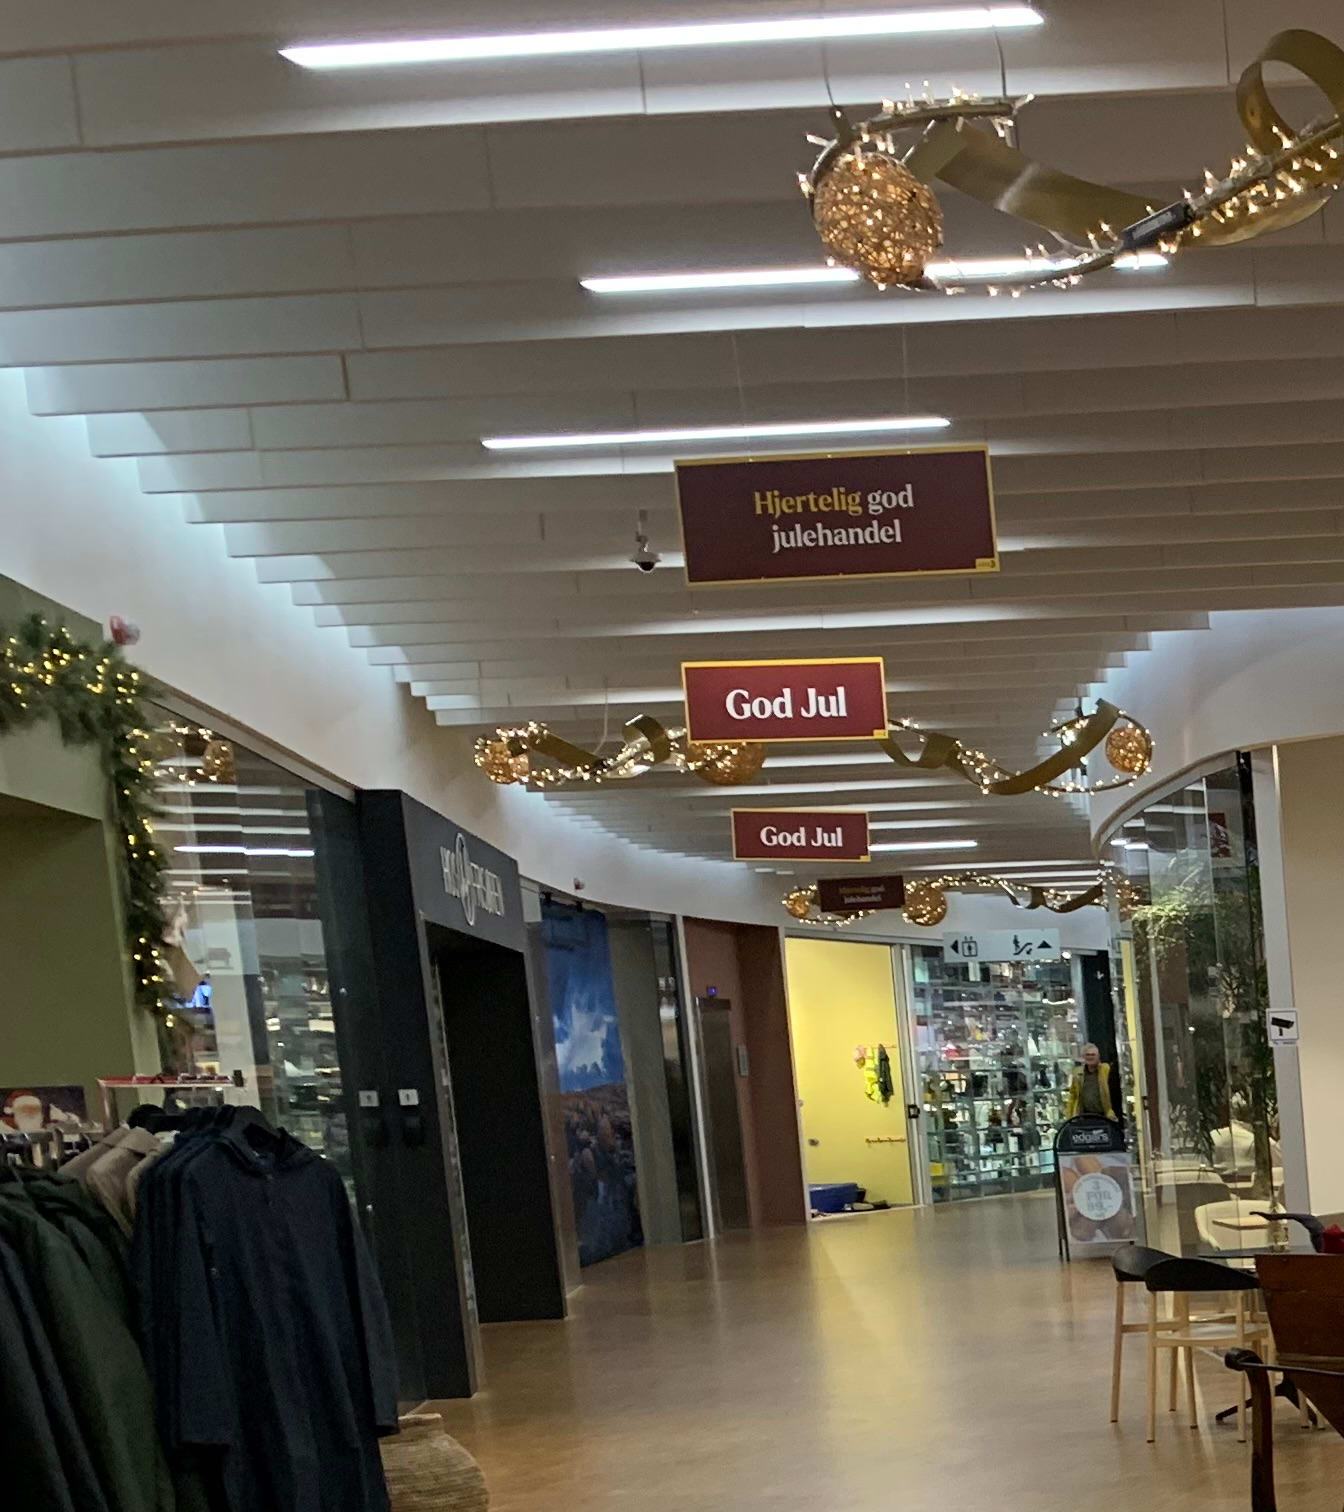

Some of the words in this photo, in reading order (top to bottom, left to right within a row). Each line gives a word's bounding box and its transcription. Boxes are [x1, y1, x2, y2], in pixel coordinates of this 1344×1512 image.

[754, 487, 863, 519] Hjertelig
[867, 484, 915, 514] god
[772, 519, 902, 553] julehandel
[725, 688, 793, 720] God
[801, 686, 847, 718] Jul
[760, 827, 806, 847] God
[811, 827, 843, 847] Jul
